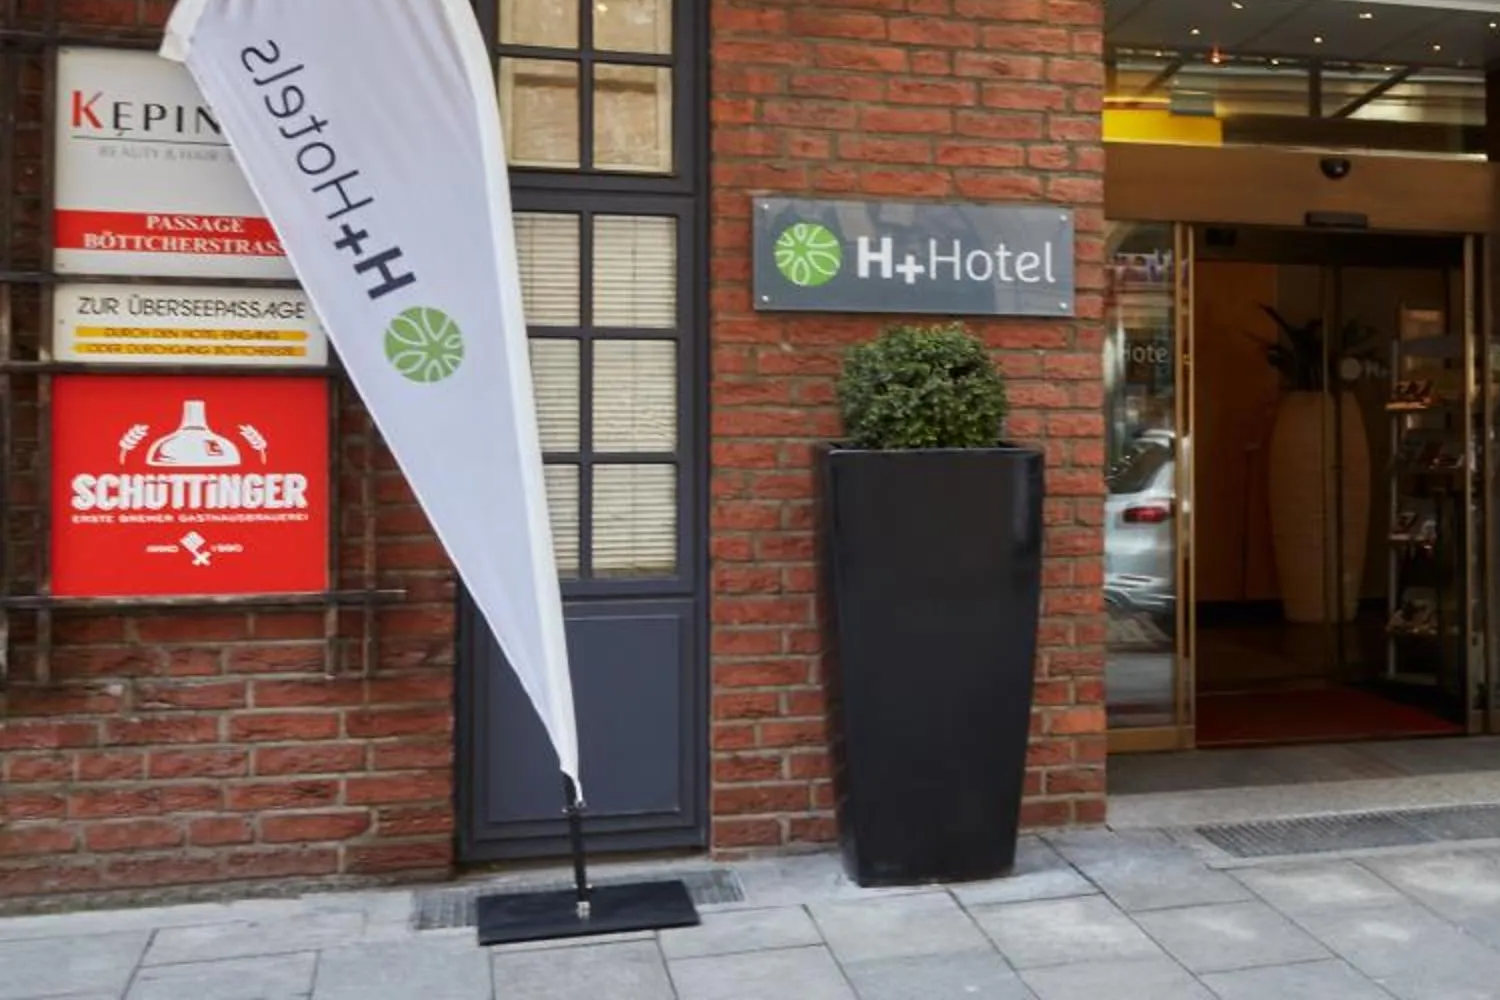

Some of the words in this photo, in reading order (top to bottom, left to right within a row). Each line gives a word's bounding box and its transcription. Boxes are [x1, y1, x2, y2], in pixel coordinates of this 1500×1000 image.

[146, 215, 244, 233] PASSAGE
[83, 231, 287, 254] BÖTTCHERSTRAS
[856, 235, 1056, 284] H+Hotel
[77, 296, 119, 315] ZUR
[128, 294, 306, 320] ÜBERSEEPASSAGE
